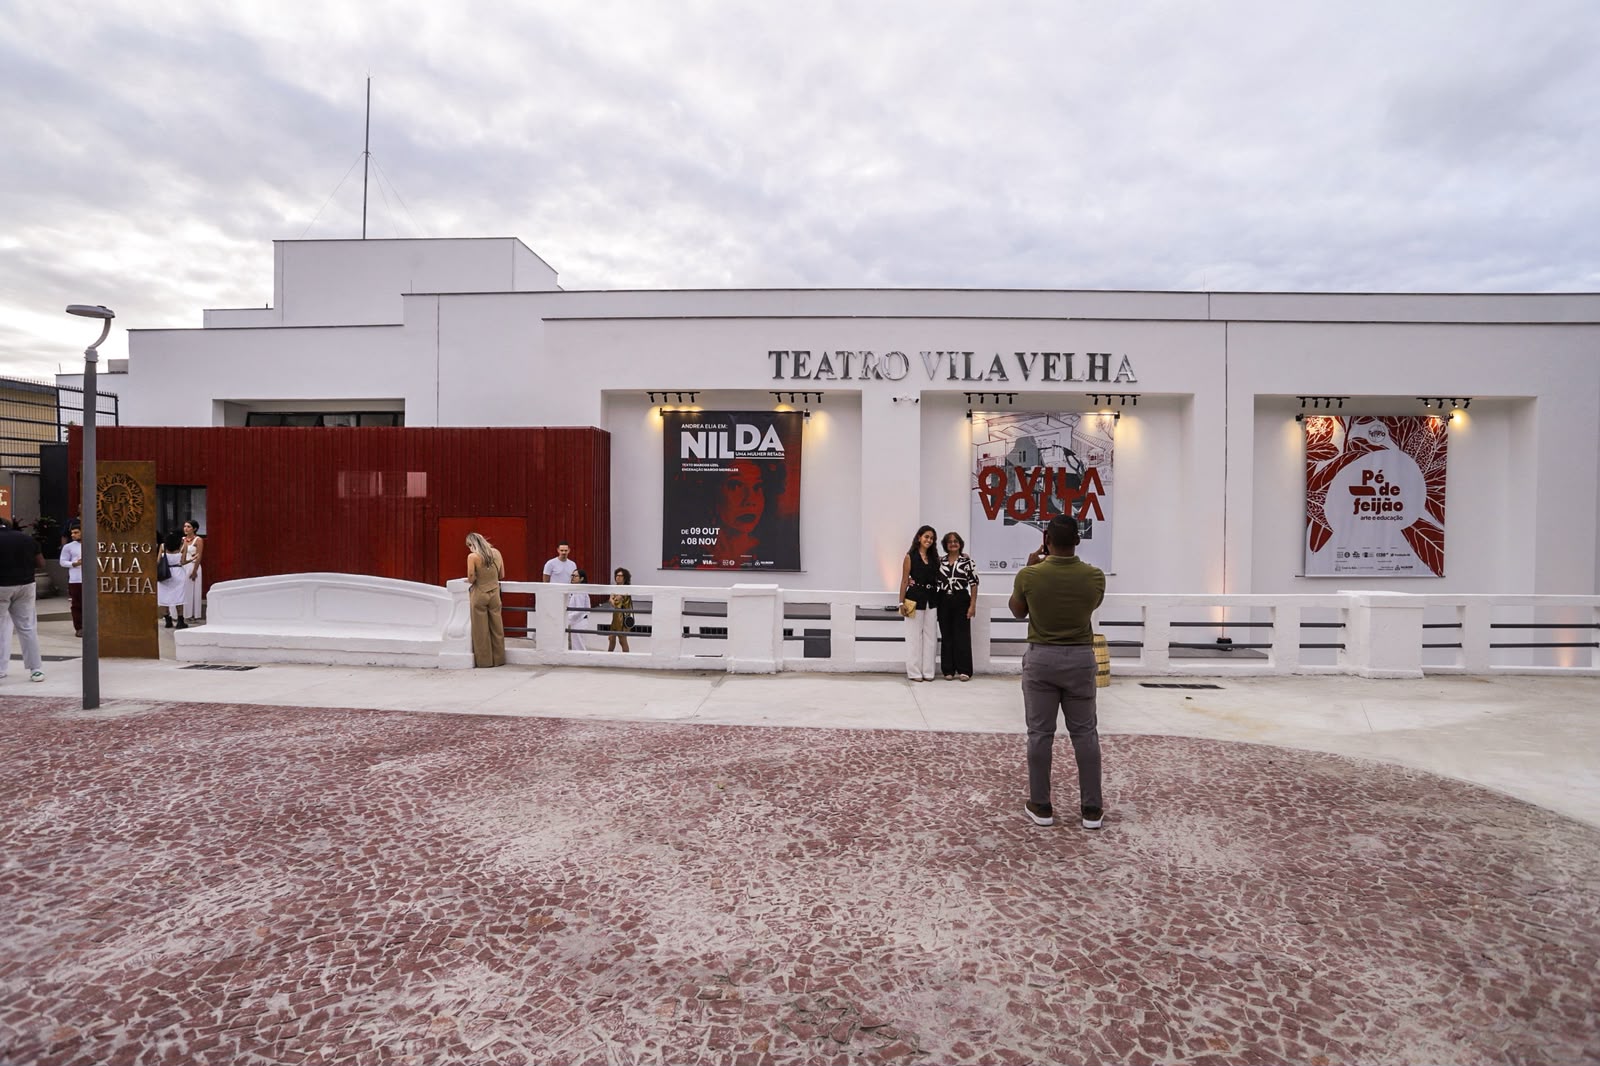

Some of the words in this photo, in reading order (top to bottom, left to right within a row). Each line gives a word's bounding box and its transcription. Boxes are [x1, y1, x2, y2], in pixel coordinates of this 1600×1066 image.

[768, 350, 910, 381] TEATRO
[919, 350, 1010, 382] VILA
[1014, 351, 1138, 384] VELHA
[1014, 467, 1106, 499] VILA
[1362, 470, 1384, 486] Pé
[1378, 482, 1400, 496] de
[978, 492, 1105, 521] VOLTA
[1353, 498, 1404, 515] feijão
[690, 527, 701, 536] 09
[702, 528, 720, 536] OUT
[98, 542, 152, 554] EATRO
[686, 538, 698, 546] 08
[97, 556, 142, 574] VILA
[97, 576, 156, 594] ELHA
